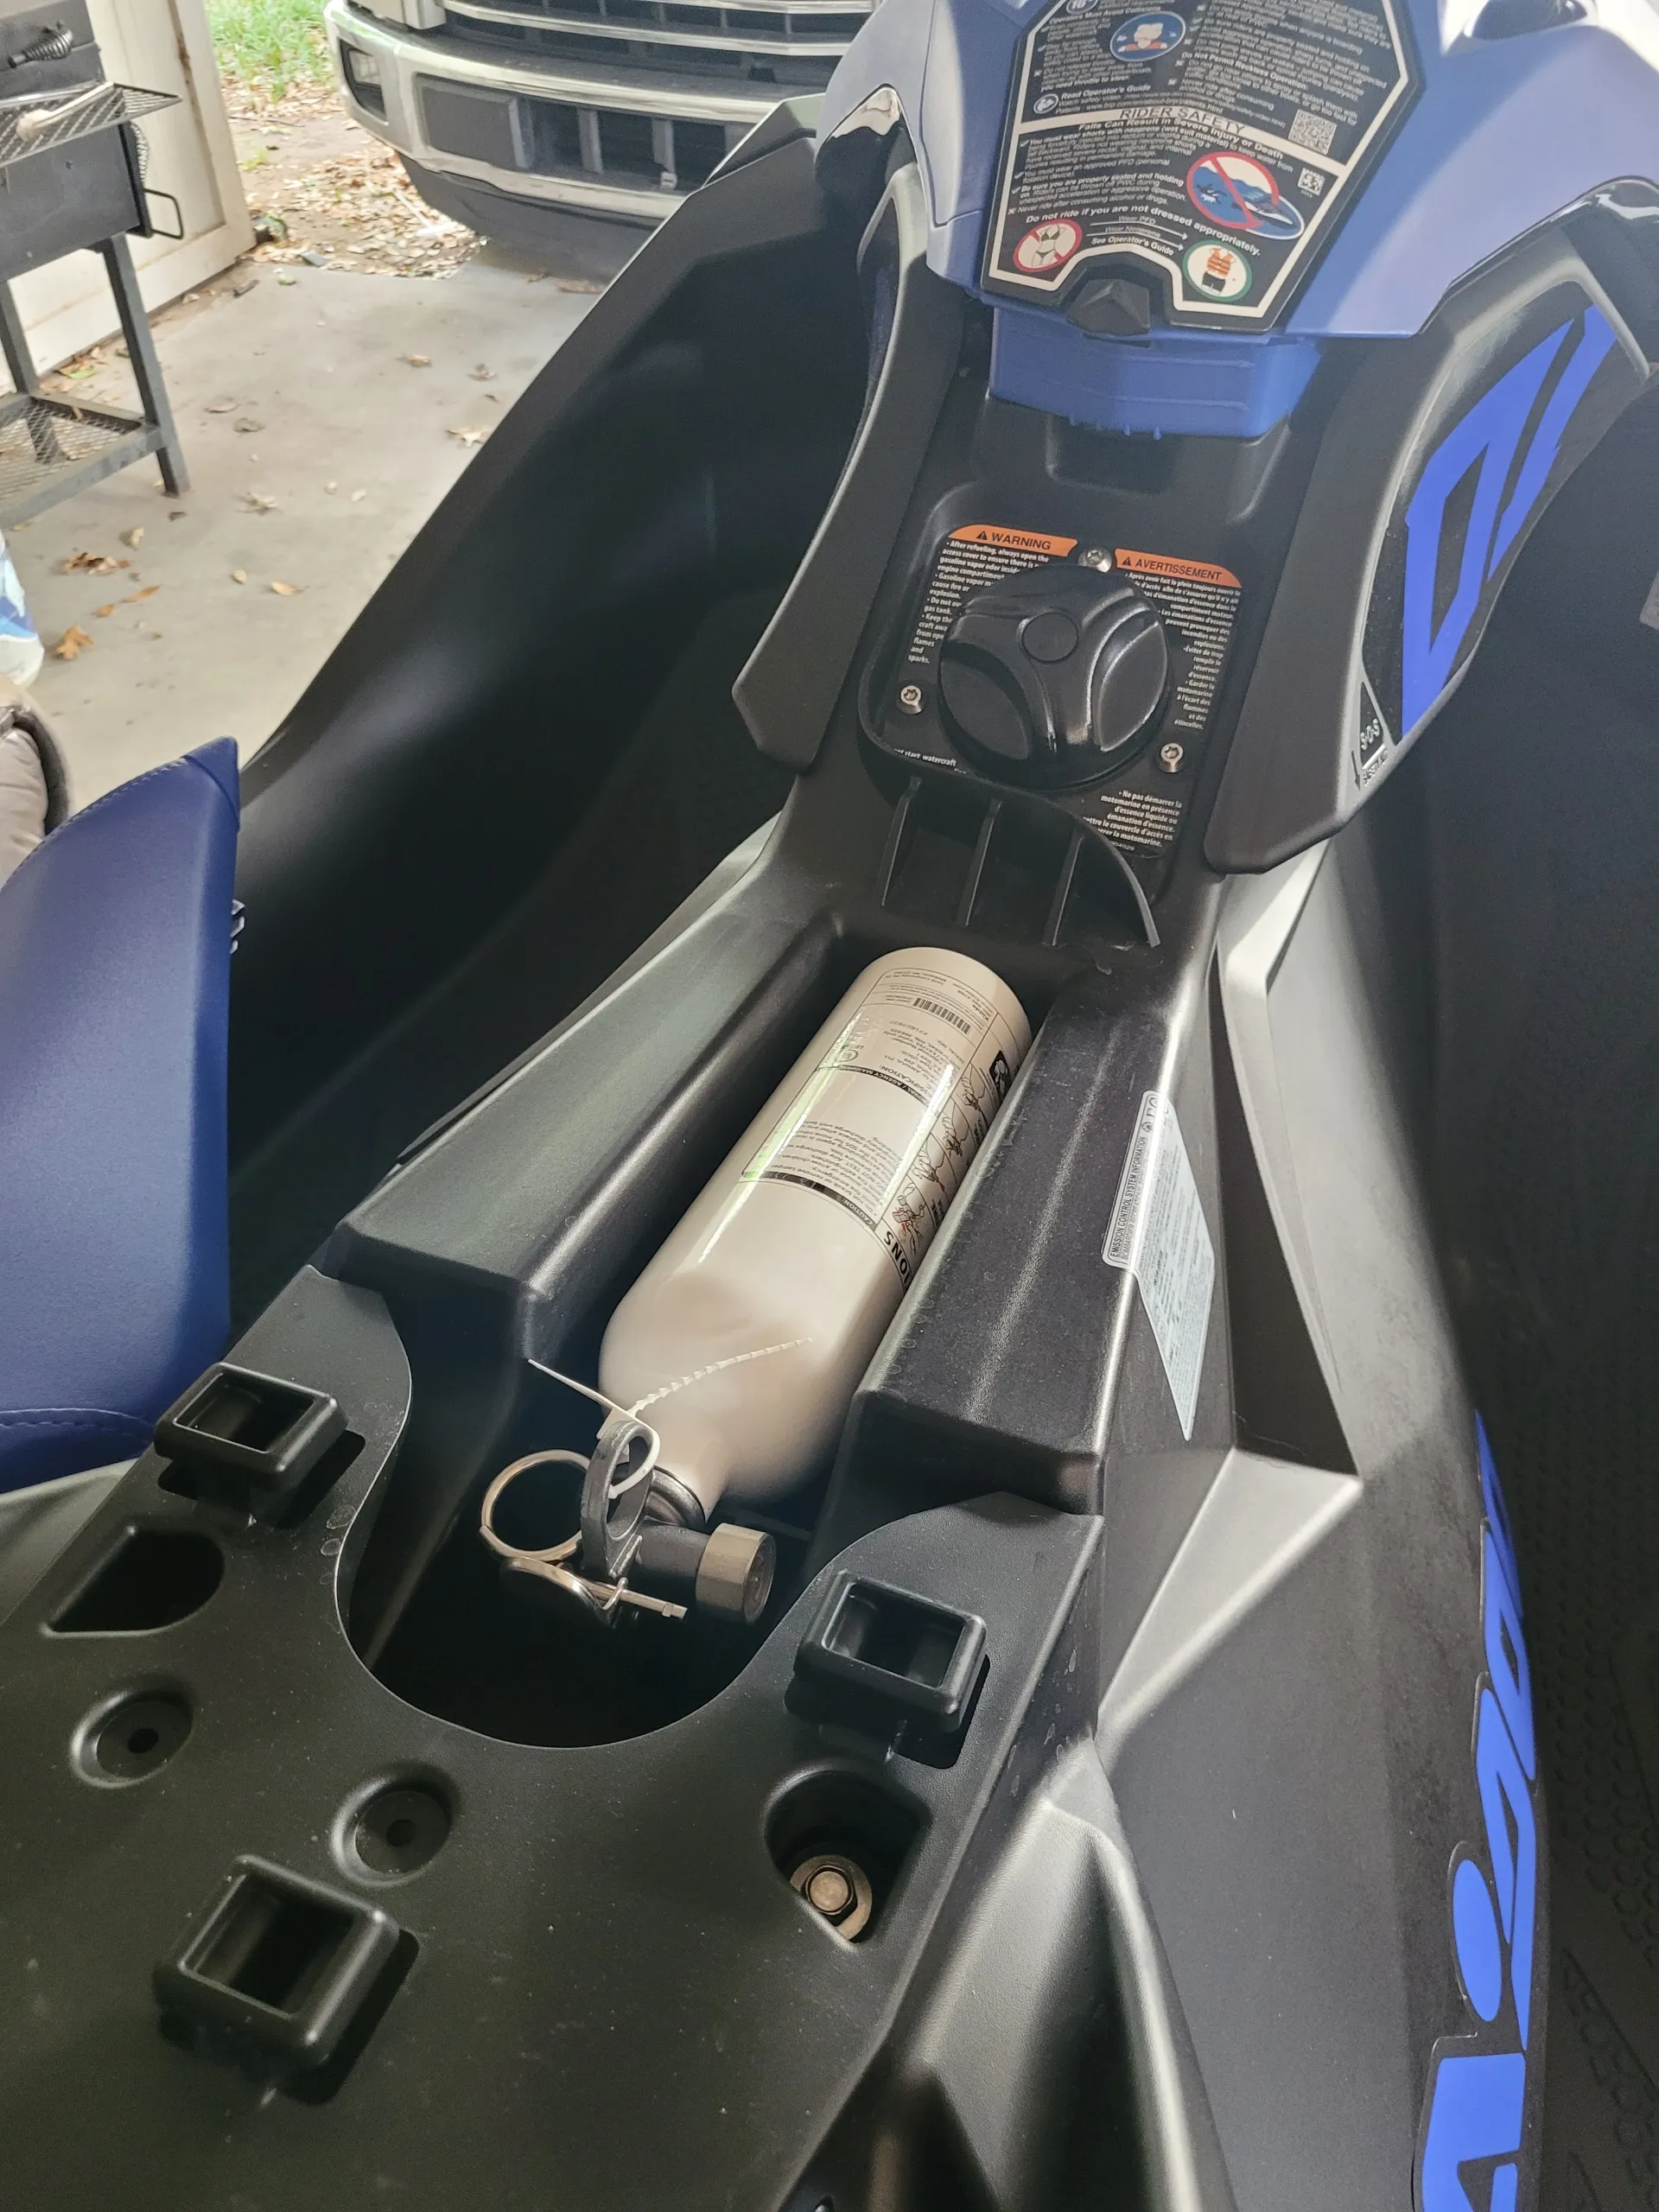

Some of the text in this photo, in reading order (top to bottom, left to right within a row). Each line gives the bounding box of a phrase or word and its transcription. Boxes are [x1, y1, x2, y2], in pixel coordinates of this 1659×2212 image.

[1120, 107, 1173, 119] RIDER
[1178, 107, 1244, 132] SAFETY
[1026, 214, 1040, 223] Do
[1041, 212, 1058, 221] not
[1060, 210, 1078, 219] ride
[1090, 206, 1110, 215] you
[1150, 207, 1192, 227] dressed
[1194, 222, 1261, 257] appropriately.
[1113, 236, 1149, 249] Operator's
[1152, 244, 1174, 256] Guide
[991, 532, 1052, 550] WARNING
[942, 549, 962, 557] access
[988, 556, 1009, 564] ensure
[1010, 559, 1027, 568] there
[999, 549, 1020, 557] always
[938, 565, 959, 574] engine
[940, 556, 967, 566] gasoline
[968, 562, 985, 570] vapor
[1135, 559, 1223, 581] AVERTISSEMENT
[938, 572, 965, 582] Gasoline
[966, 577, 985, 586] vapor
[930, 589, 961, 599] explosion.
[925, 613, 942, 622] Keep
[916, 629, 931, 638] from
[913, 638, 935, 647] flames
[908, 654, 930, 664] sparks.
[1177, 686, 1213, 697] motomarine
[1189, 680, 1208, 689] Garder
[1183, 704, 1209, 714] flammes
[923, 755, 957, 766] watercraft
[1101, 795, 1141, 809] motomarine
[1151, 805, 1179, 817] présence
[1144, 795, 1175, 806] démarrer
[1115, 805, 1144, 817] d'essence
[1145, 812, 1167, 823] liquide
[1107, 813, 1175, 833] émanation d'essence.
[1110, 823, 1140, 834] couvercle
[1141, 828, 1163, 839] d'accès
[1121, 833, 1162, 848] motomarine.
[874, 1071, 902, 1086] AGENCY
[1130, 1136, 1147, 1173] INFORMATION
[1125, 1174, 1137, 1197] SYSTEM
[842, 1198, 873, 1225] CAUTION:
[1117, 1198, 1132, 1226] CONTROL
[1109, 1228, 1124, 1257] EMISSION
